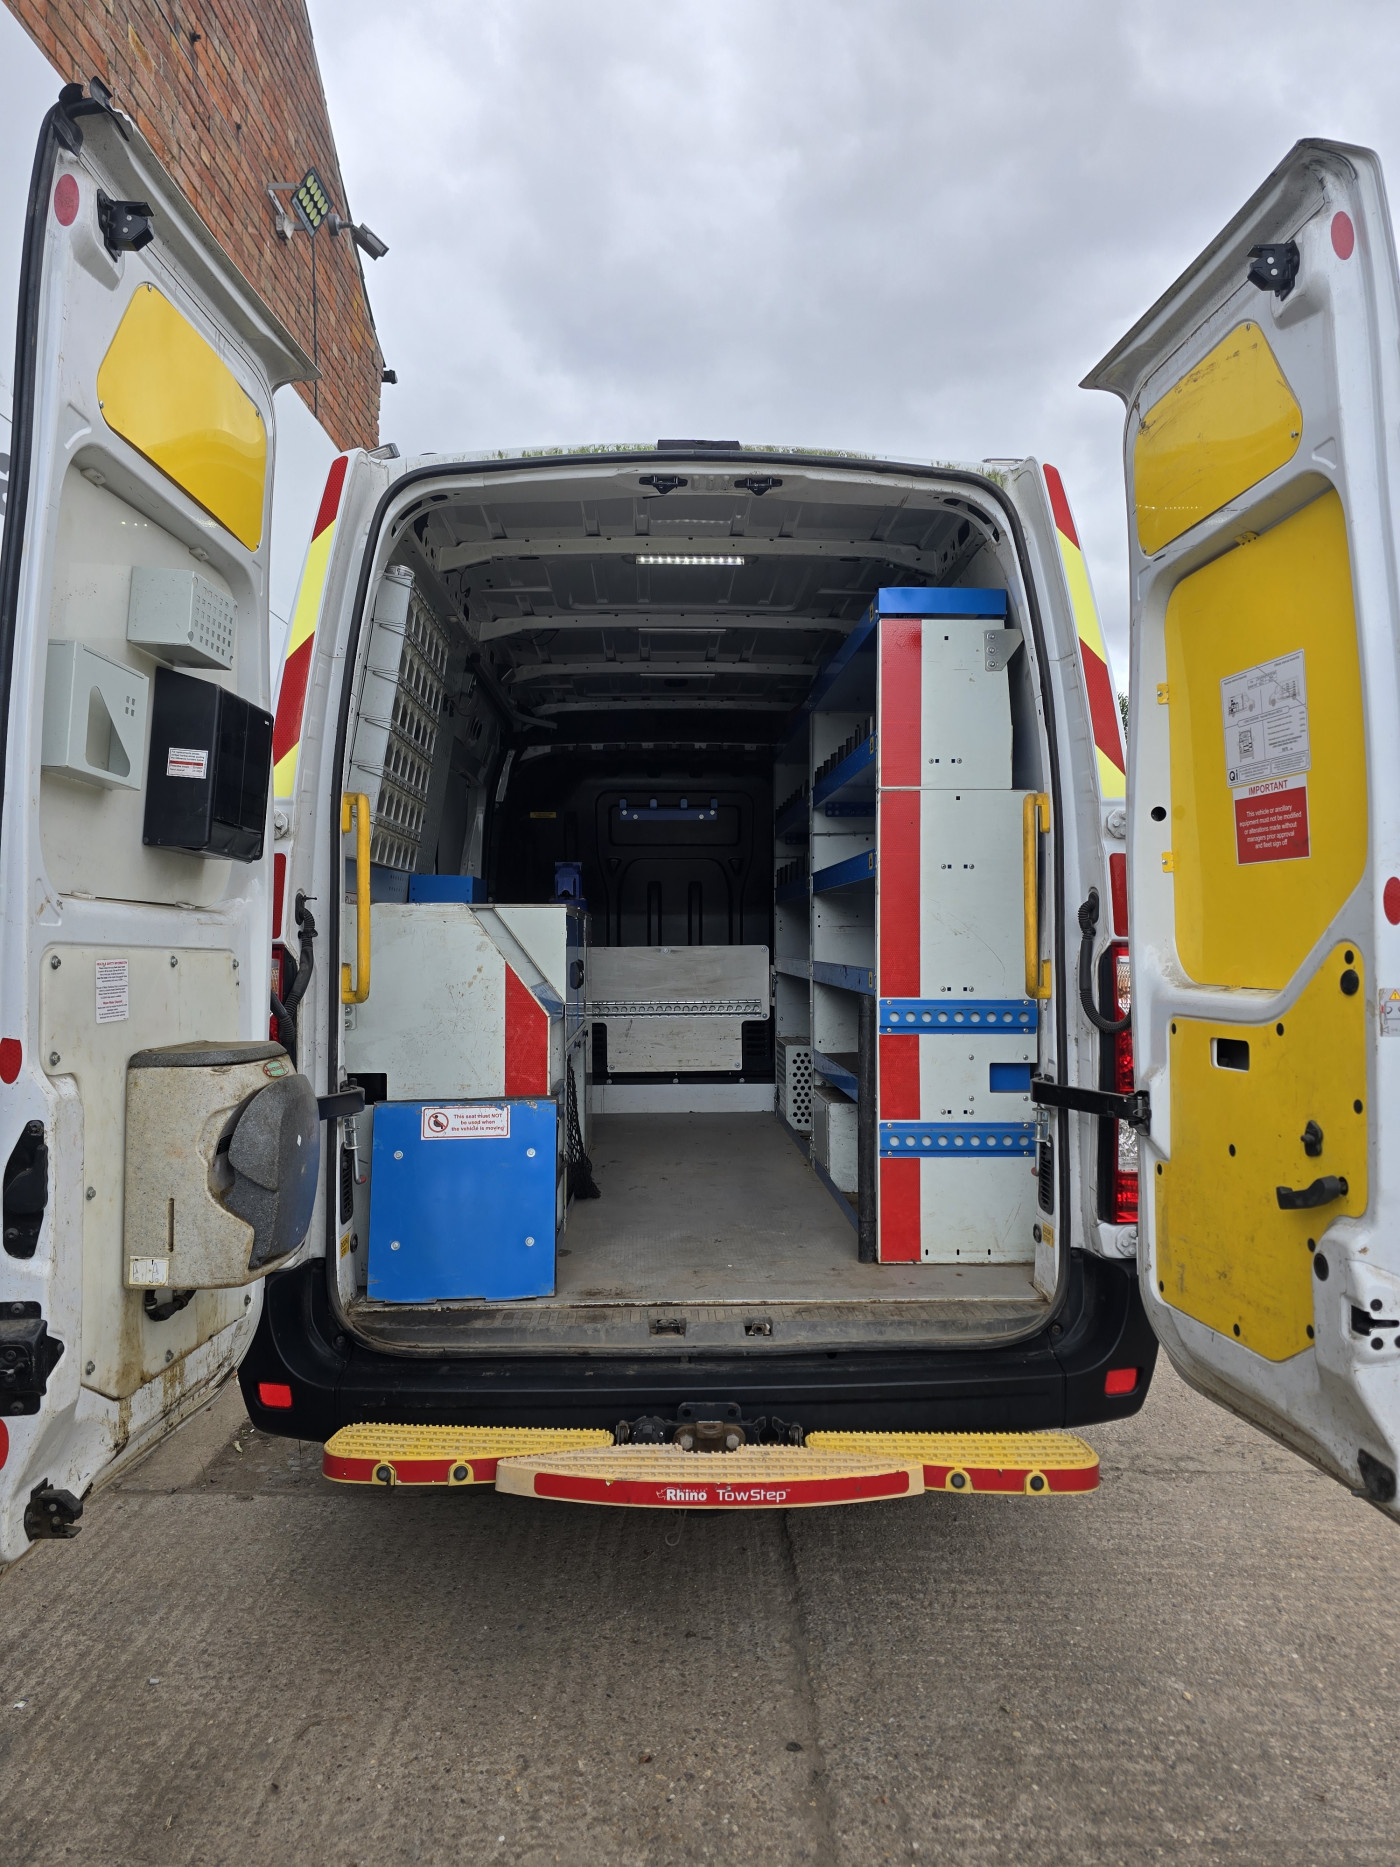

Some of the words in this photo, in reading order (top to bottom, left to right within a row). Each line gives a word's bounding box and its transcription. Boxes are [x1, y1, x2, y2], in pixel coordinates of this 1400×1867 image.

[1249, 780, 1288, 795] IMPORTANT
[1239, 819, 1259, 827] equipment
[1284, 812, 1302, 820] modified
[1276, 830, 1295, 839] approval
[1272, 840, 1281, 848] sign
[666, 1488, 707, 1501] Rhino
[716, 1489, 787, 1503] TowStep
